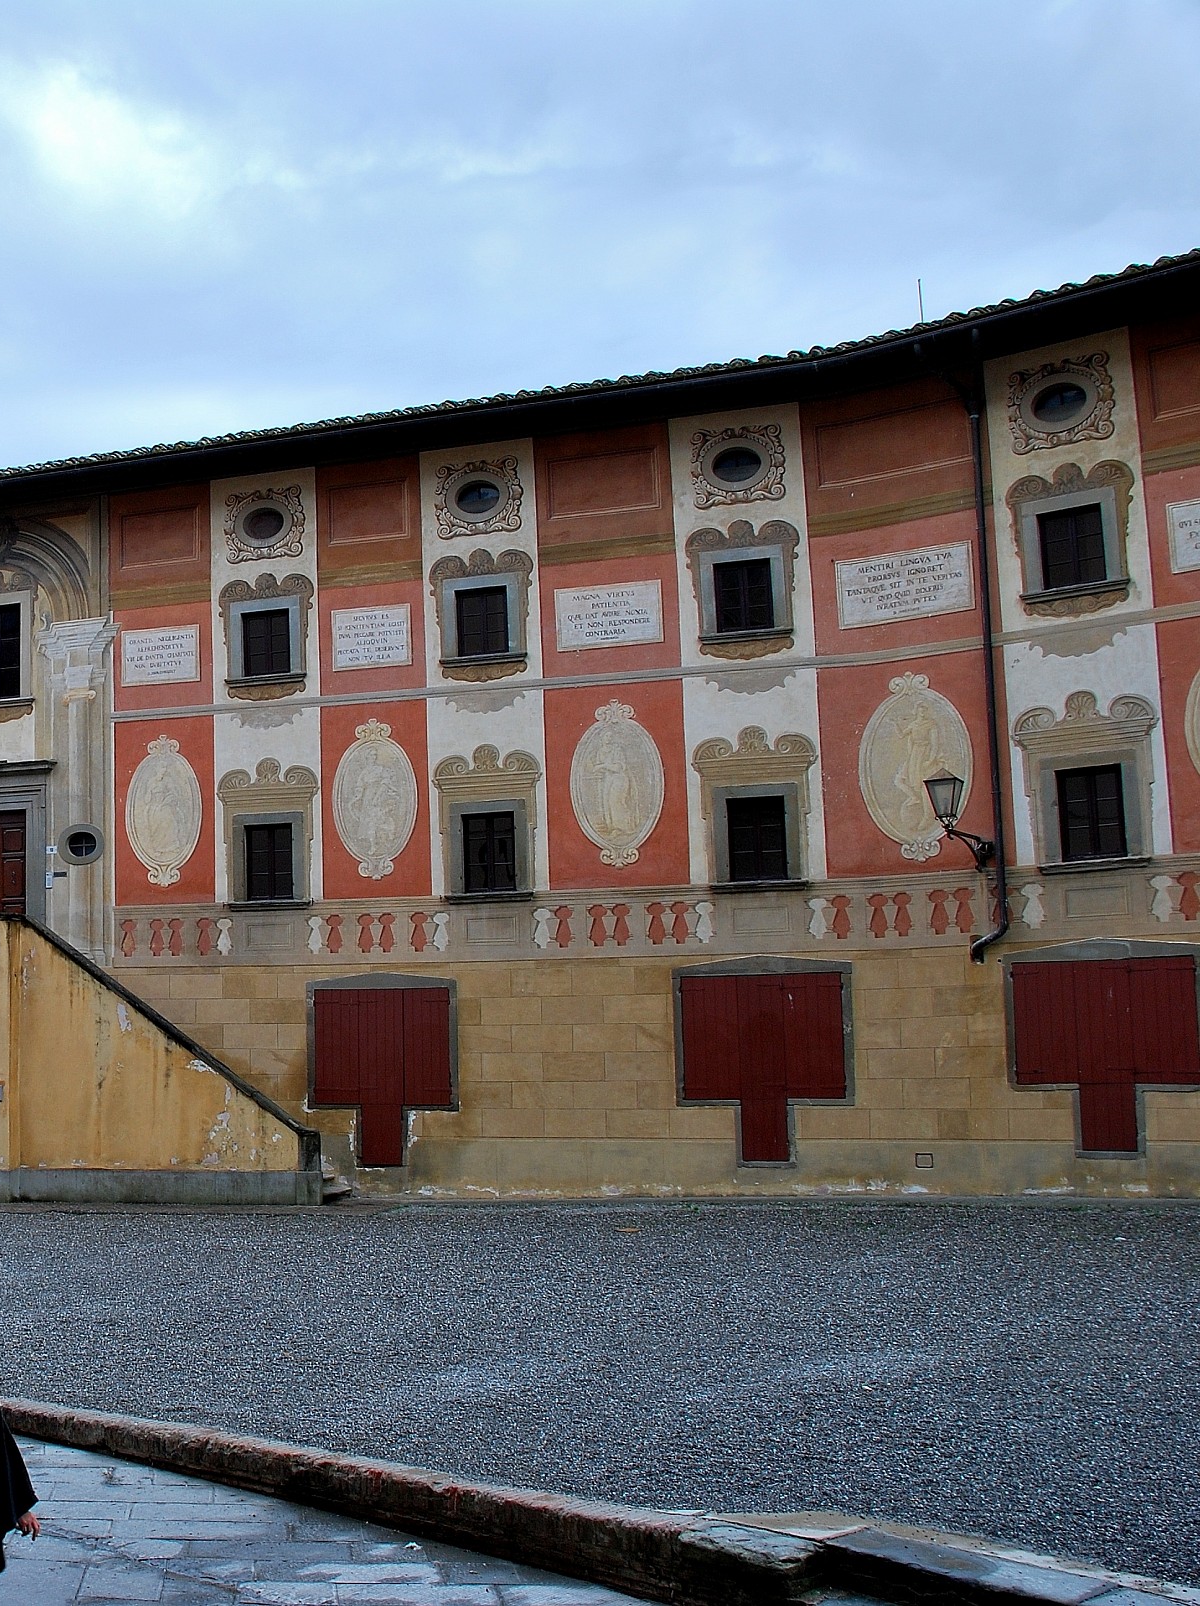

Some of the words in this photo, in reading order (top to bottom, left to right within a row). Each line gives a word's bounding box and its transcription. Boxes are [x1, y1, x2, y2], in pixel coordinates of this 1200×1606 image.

[857, 562, 894, 575] MENTIRI
[900, 556, 931, 567] LINGVA
[936, 552, 953, 561] TVA
[867, 571, 900, 583] PRORSVS
[907, 564, 944, 576] IGNORET
[845, 584, 886, 597] TANTAQVE
[889, 581, 902, 590] SIT
[606, 590, 635, 599] VIRTVS
[912, 595, 937, 604] PVTES
[591, 601, 631, 609] PATIENTIA
[587, 620, 604, 629] NON
[608, 617, 650, 627] RESPONDERE
[585, 629, 626, 637] CONTRARIA
